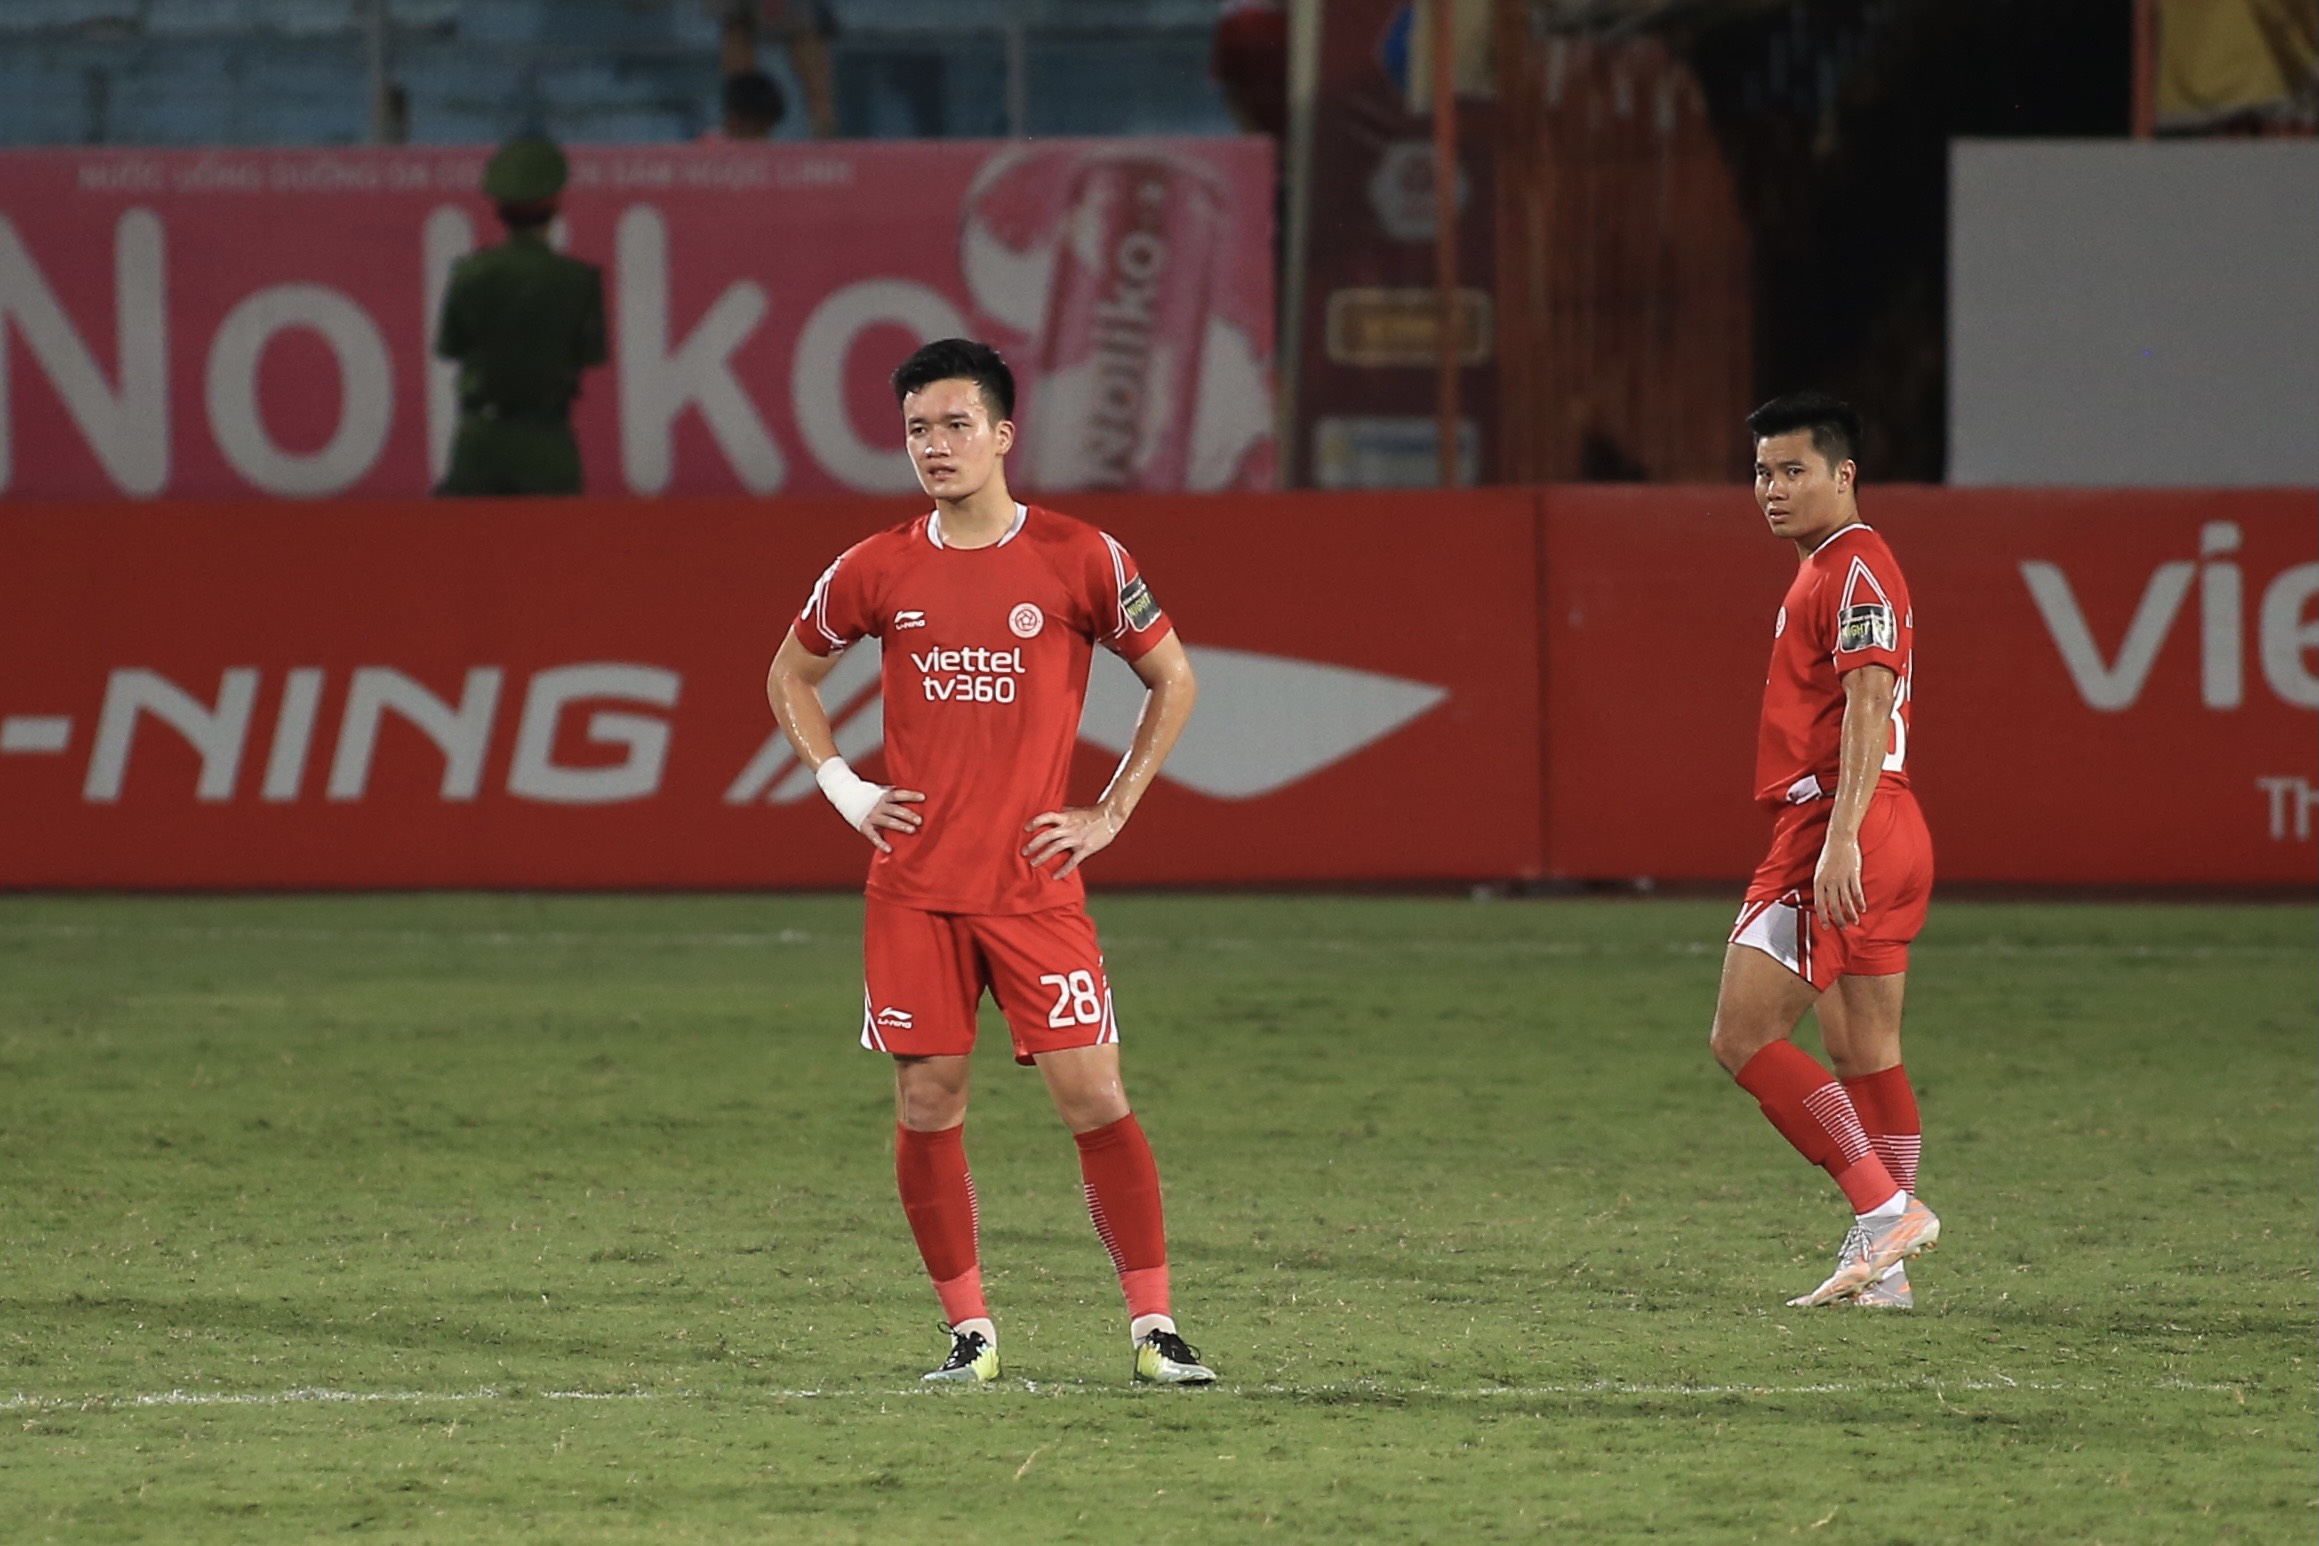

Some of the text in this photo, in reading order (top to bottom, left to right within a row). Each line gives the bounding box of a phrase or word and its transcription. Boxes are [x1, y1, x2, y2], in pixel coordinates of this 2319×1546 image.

[910, 645, 1026, 674] viettel
[922, 673, 1016, 704] tv360
[1039, 969, 1102, 1029] 28
